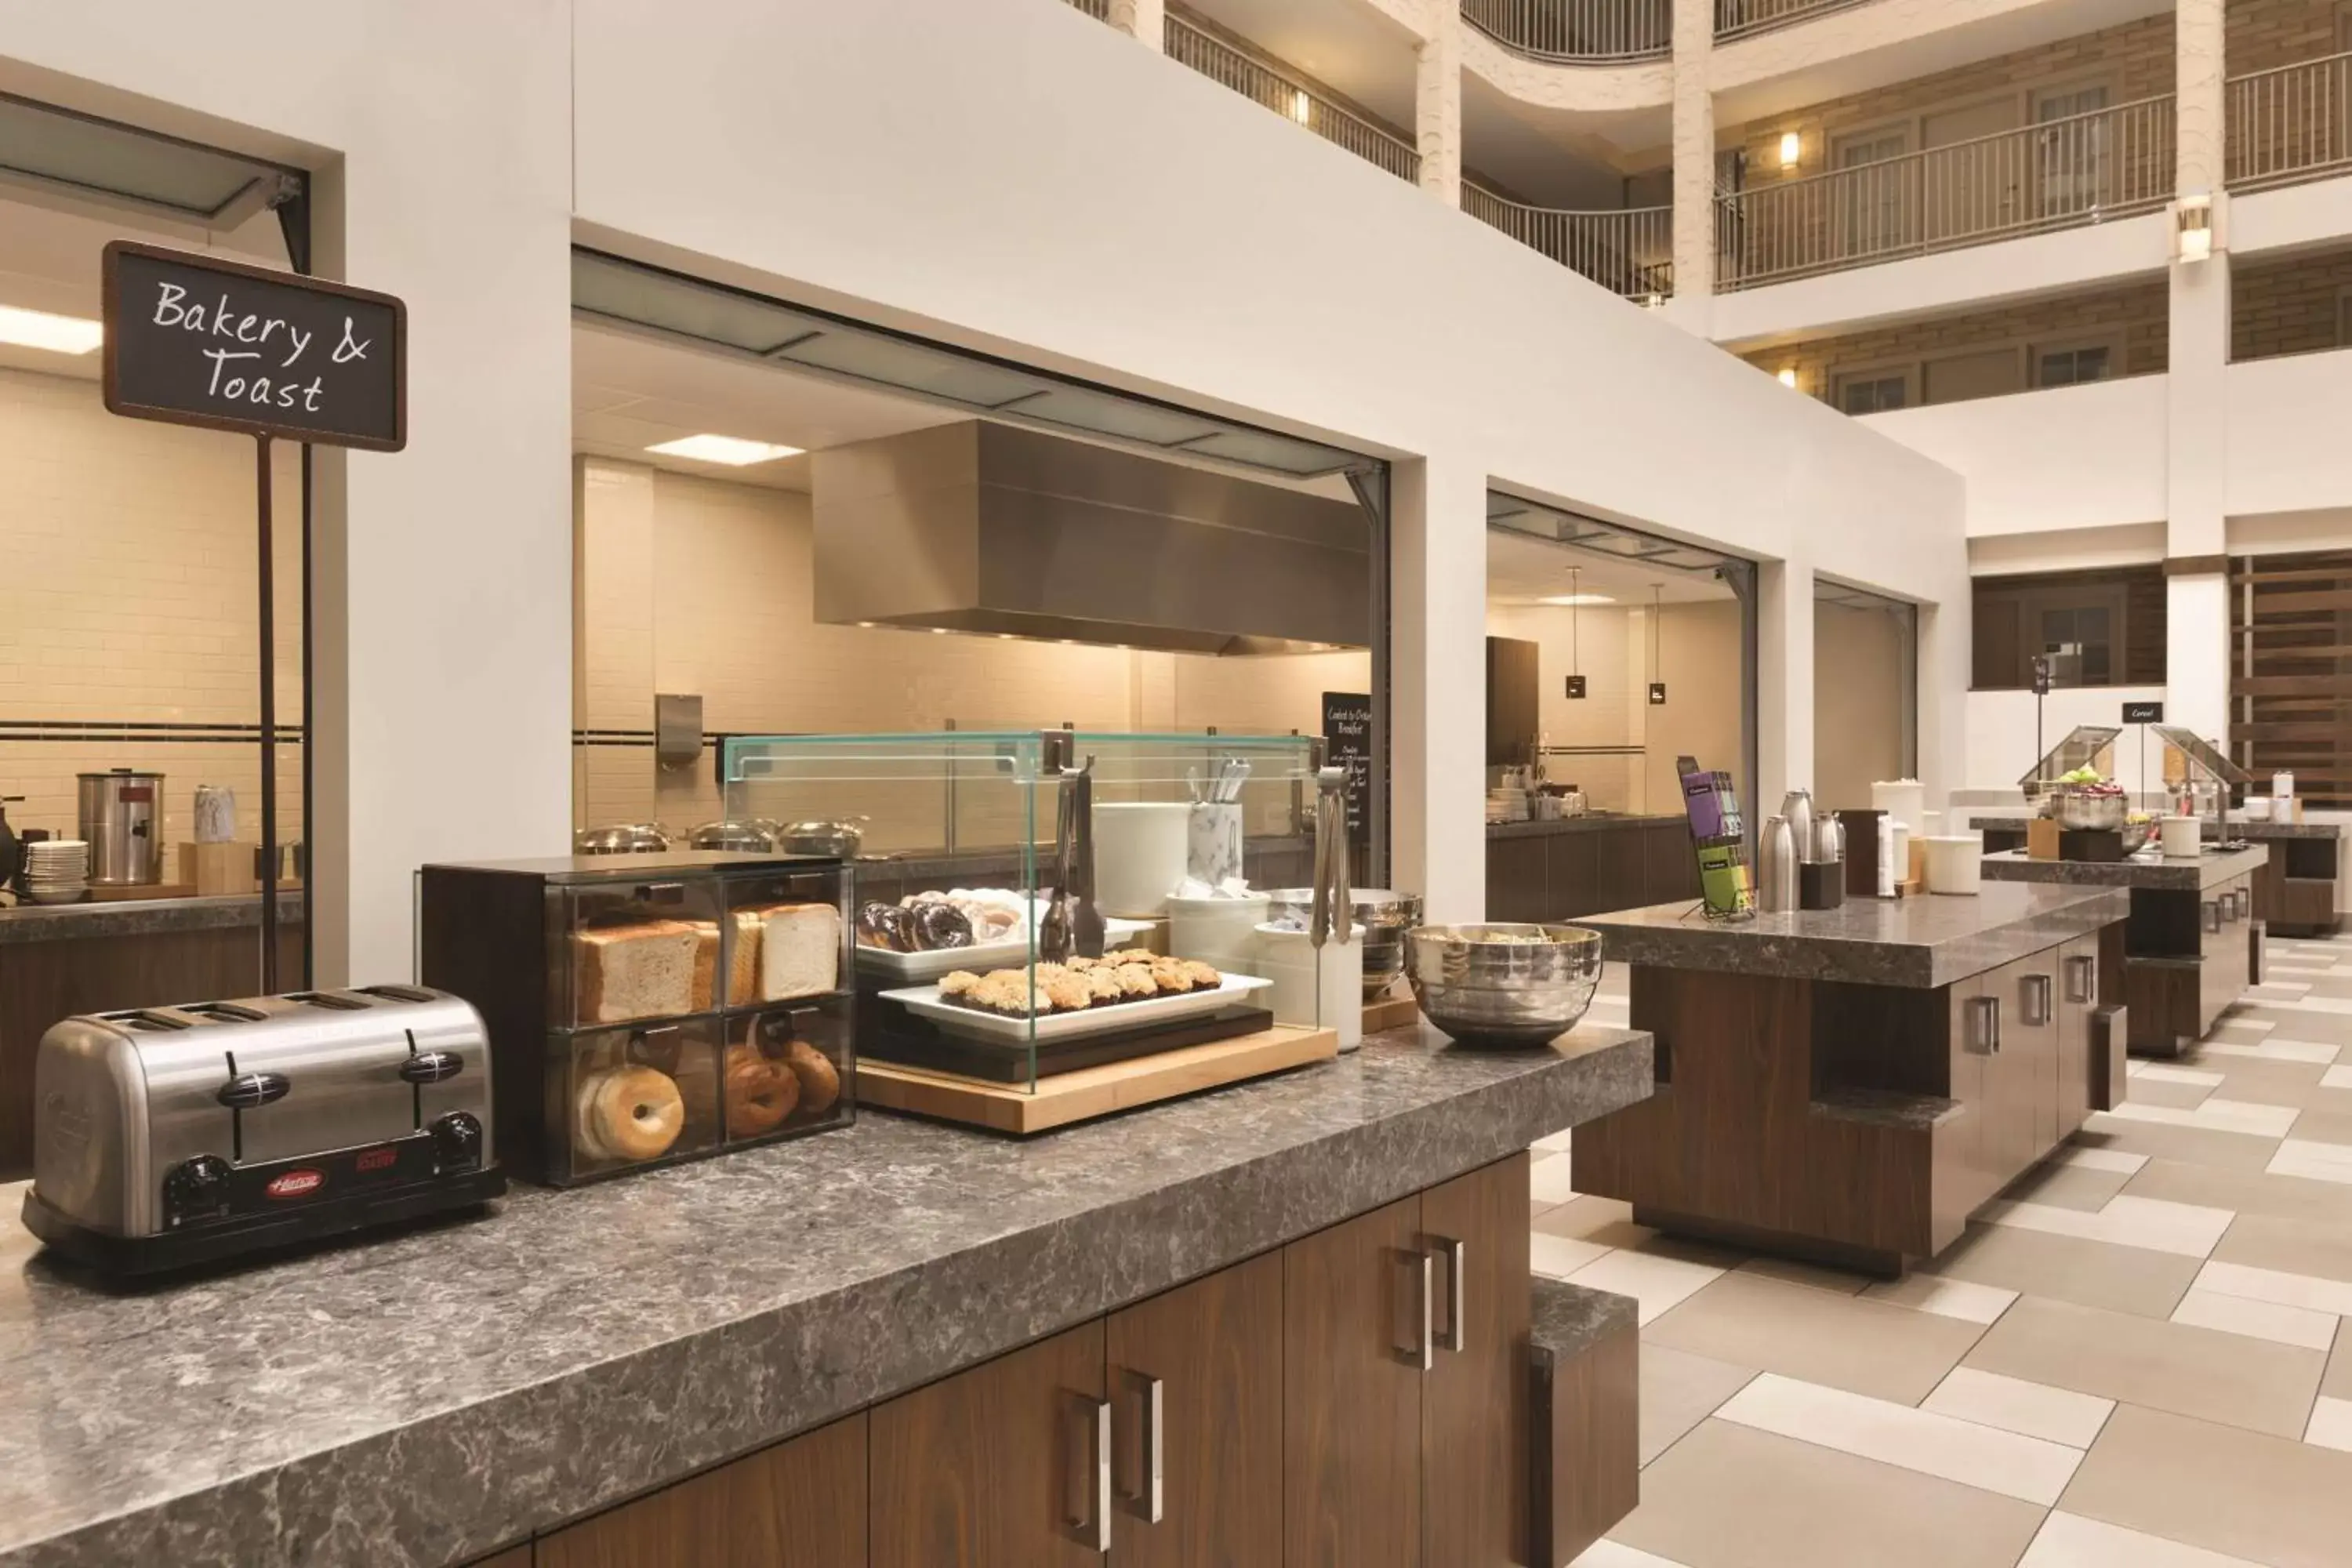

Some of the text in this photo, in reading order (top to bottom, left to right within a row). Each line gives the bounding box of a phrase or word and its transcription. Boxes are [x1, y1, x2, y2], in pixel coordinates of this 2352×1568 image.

[153, 281, 373, 367] Bakery &
[202, 347, 323, 412] Toast
